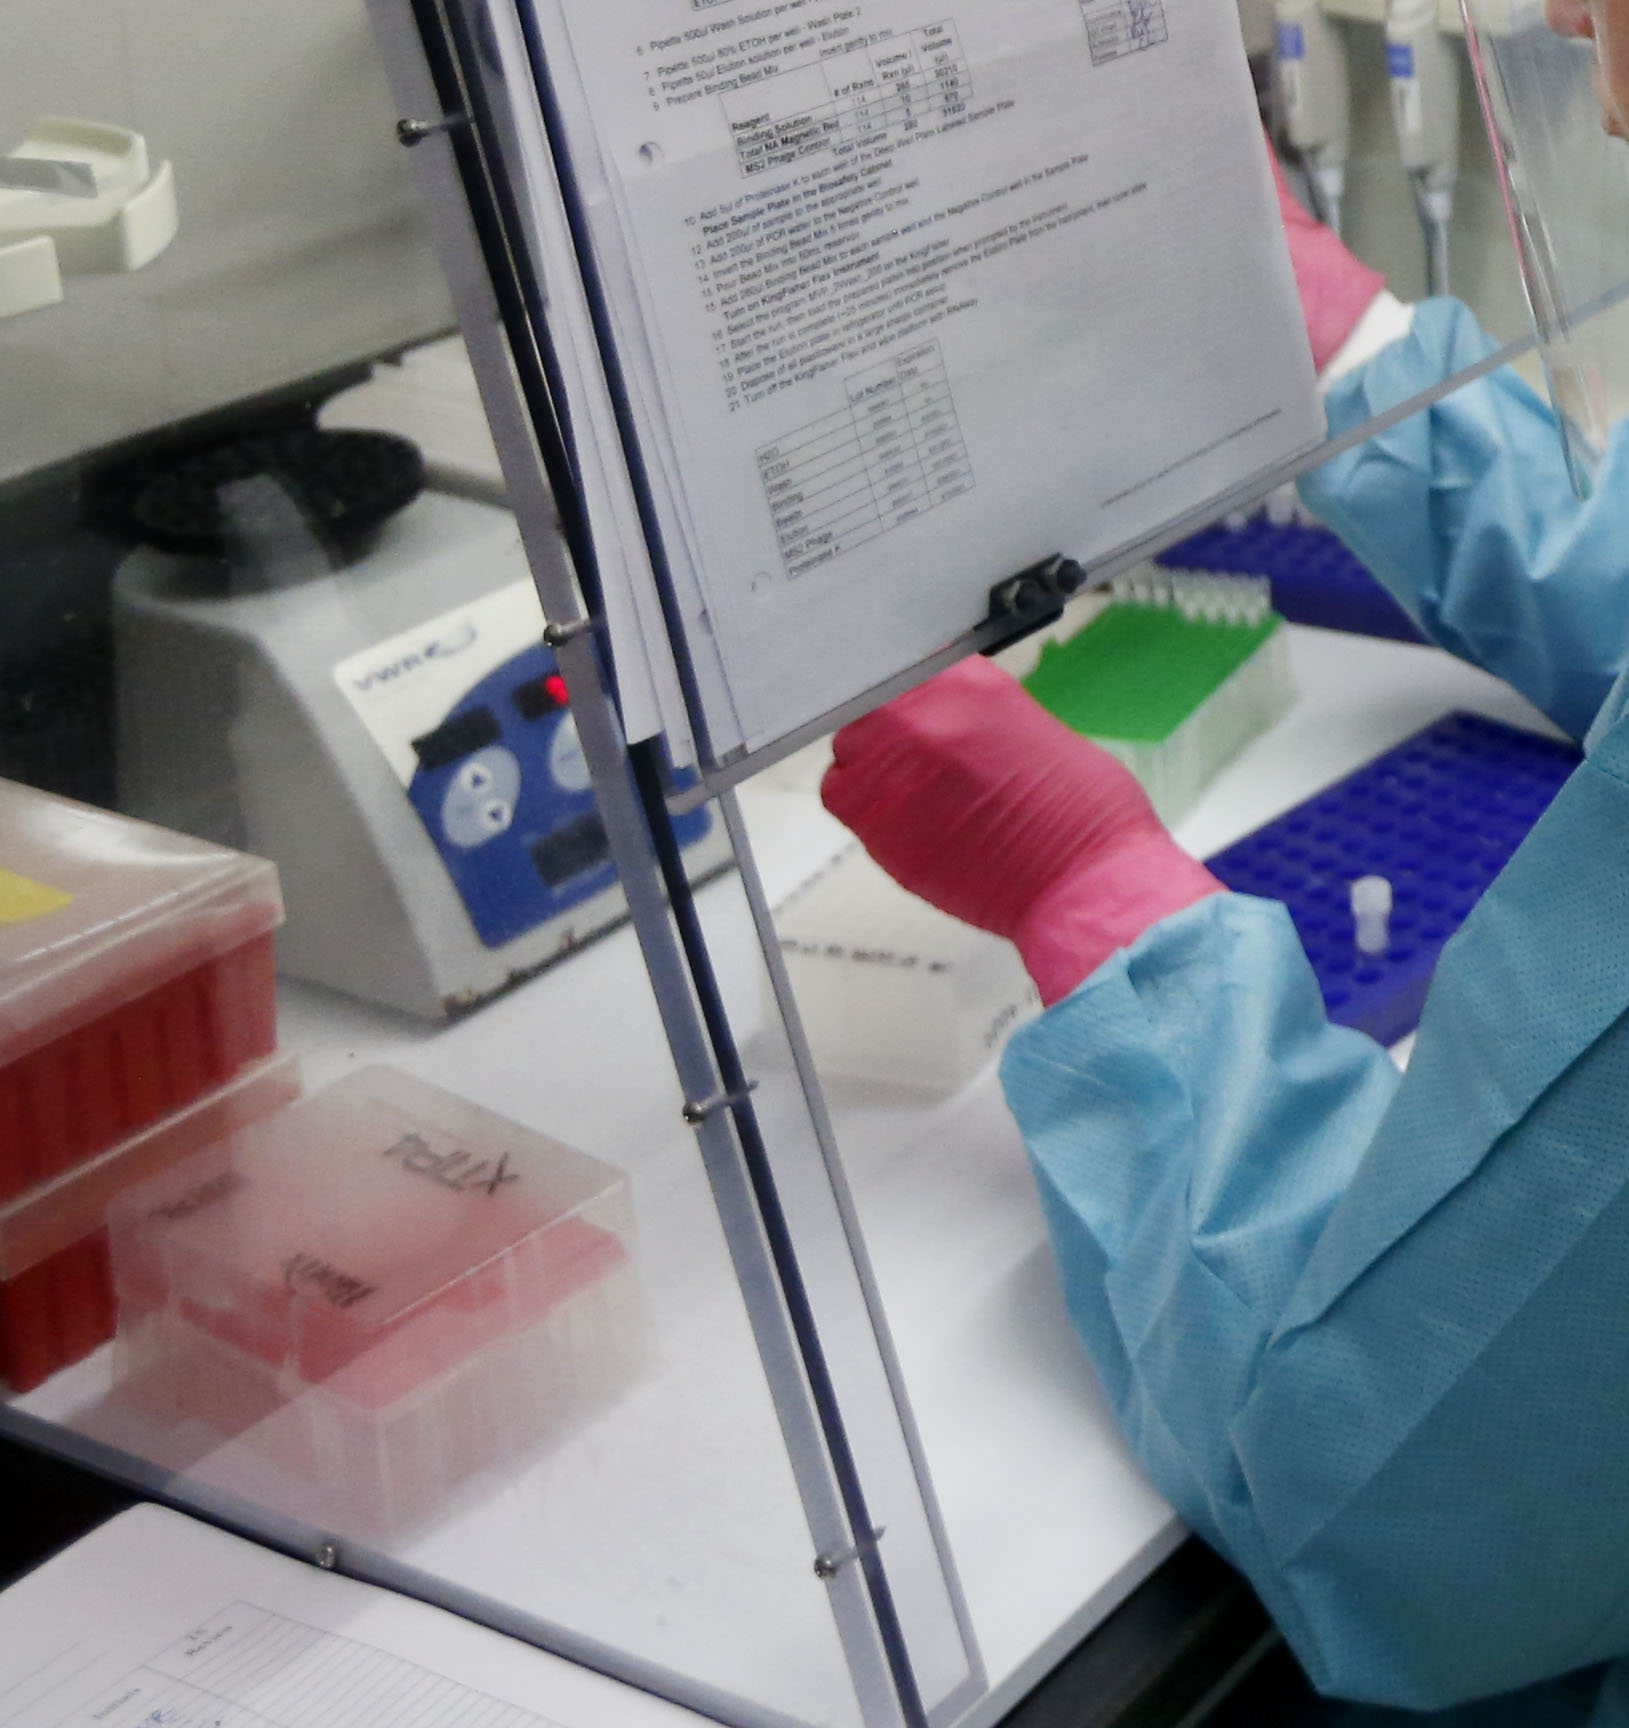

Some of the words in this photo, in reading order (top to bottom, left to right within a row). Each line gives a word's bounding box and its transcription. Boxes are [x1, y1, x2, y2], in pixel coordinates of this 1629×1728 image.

[731, 111, 771, 134] Reagent
[736, 127, 773, 149] Binding
[773, 113, 812, 134] Solution
[855, 130, 887, 148] Volume
[729, 205, 765, 227] Sample
